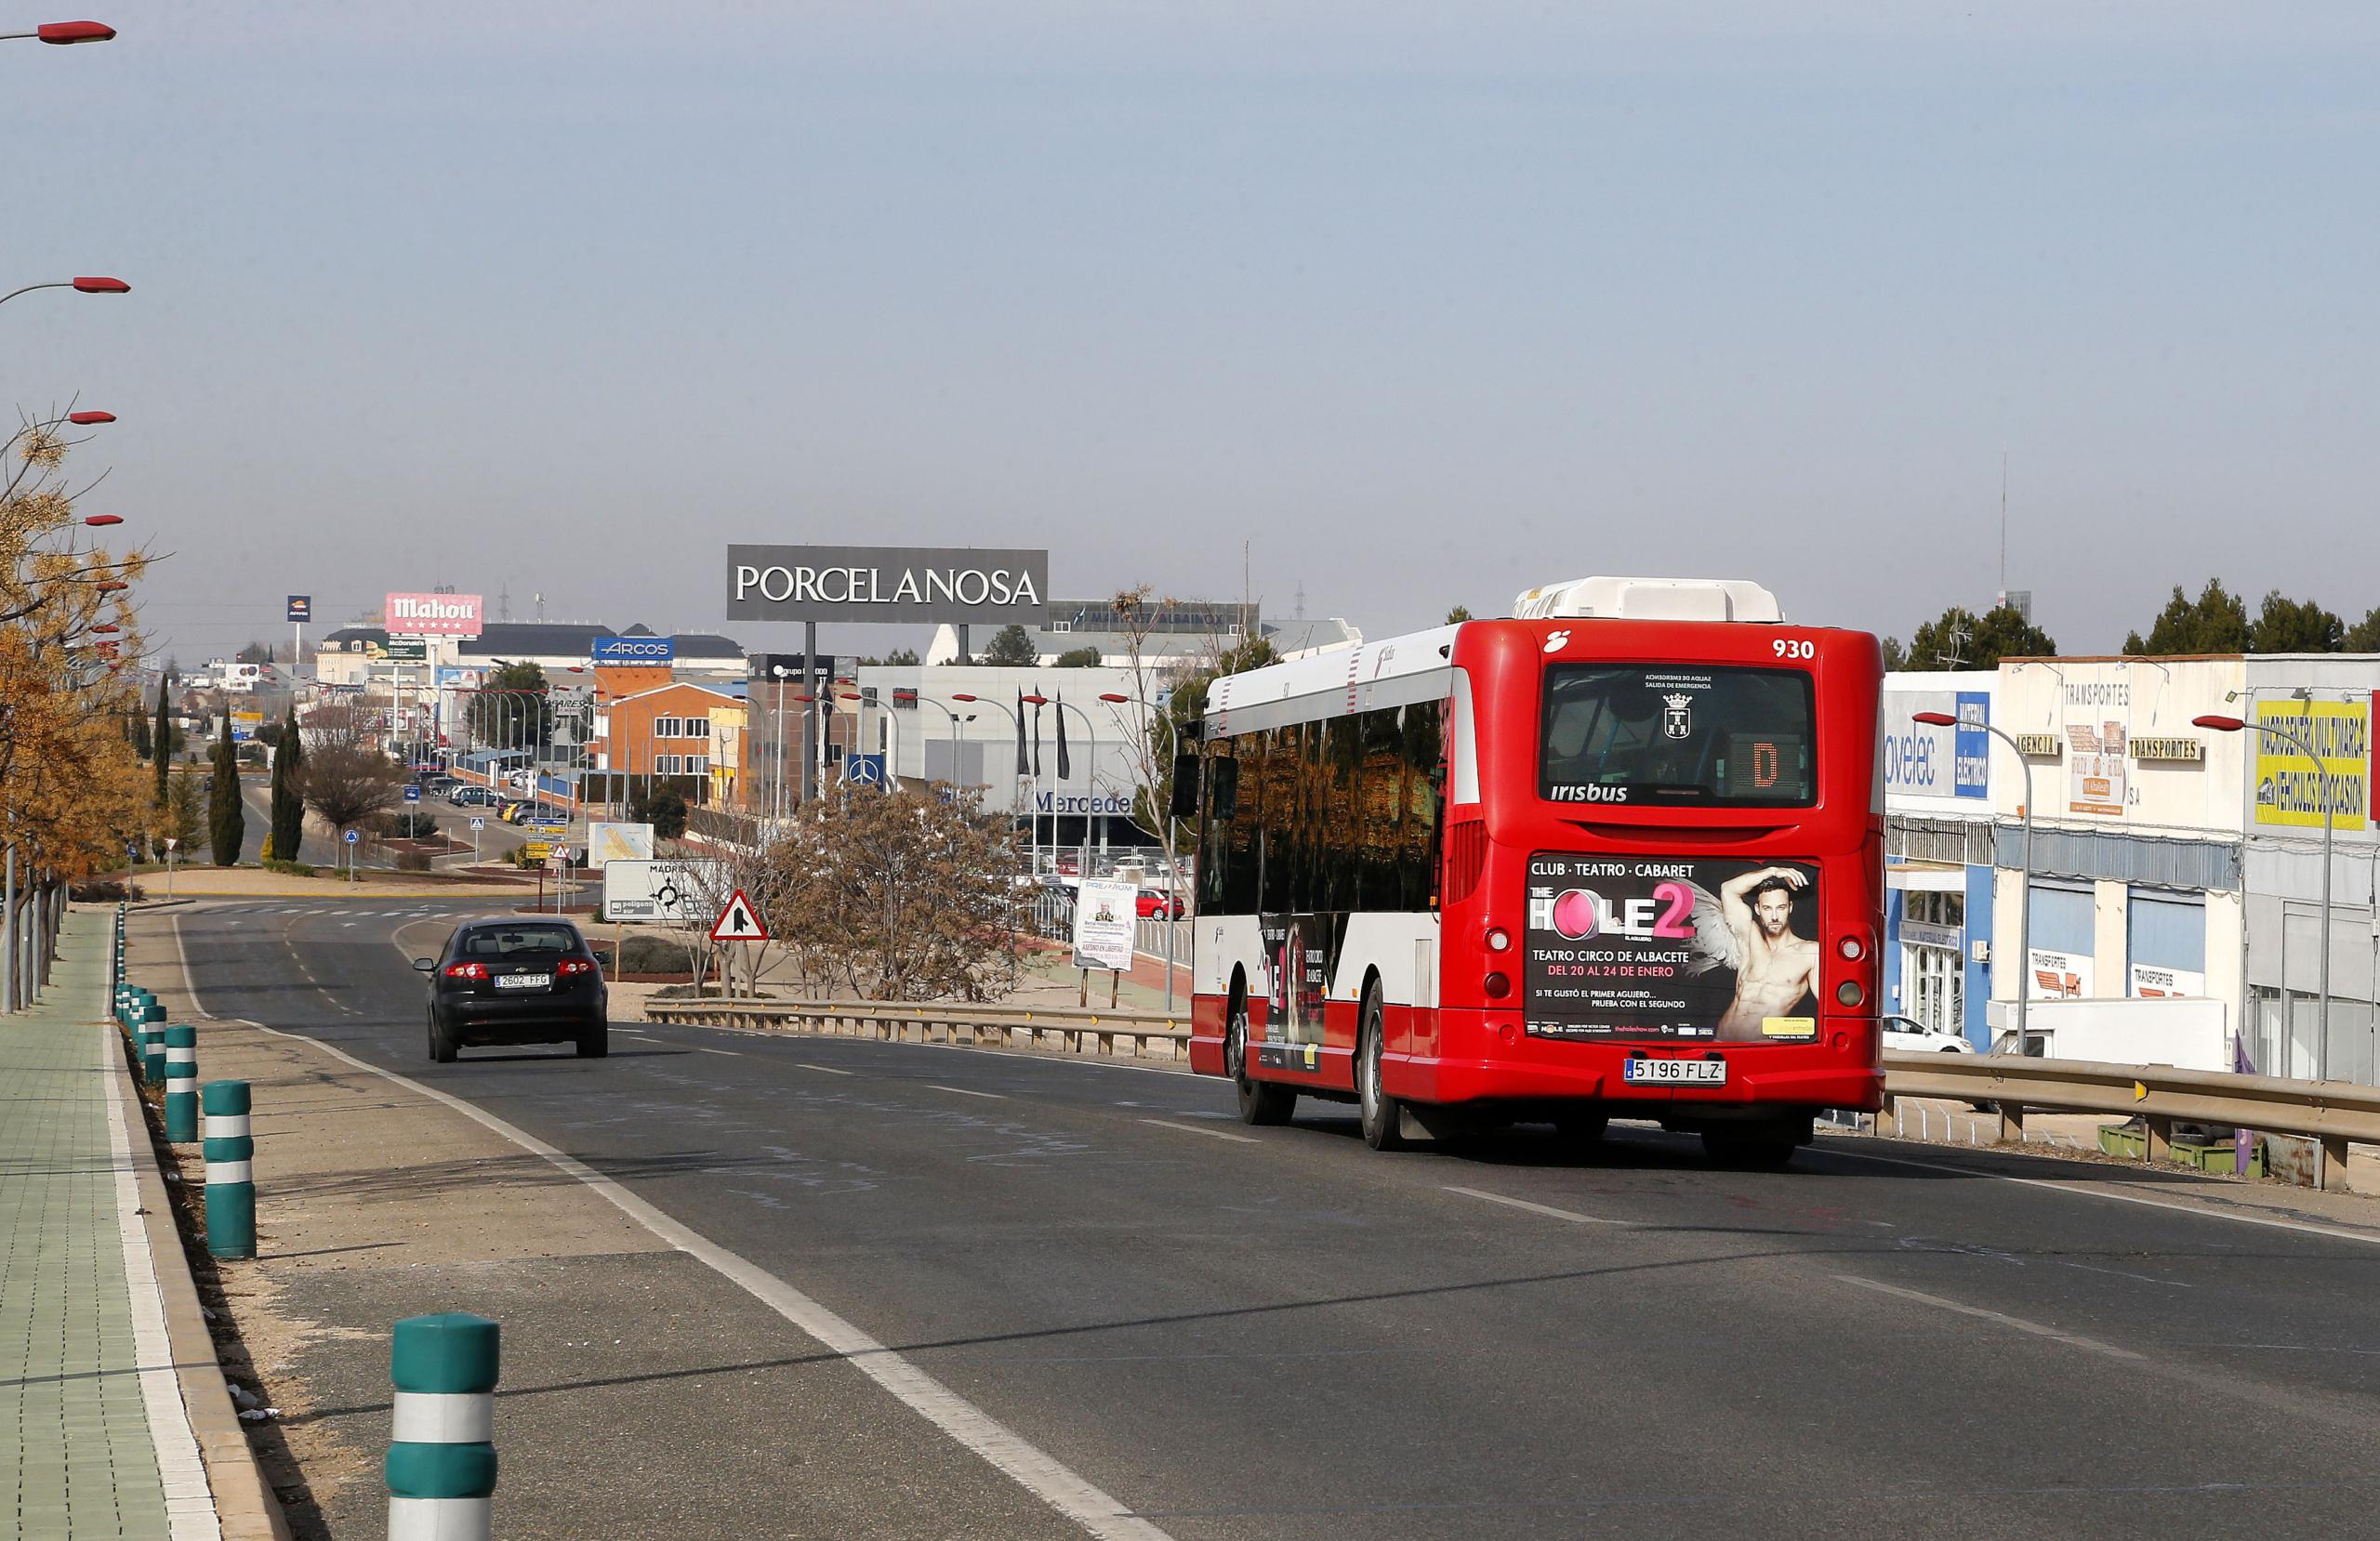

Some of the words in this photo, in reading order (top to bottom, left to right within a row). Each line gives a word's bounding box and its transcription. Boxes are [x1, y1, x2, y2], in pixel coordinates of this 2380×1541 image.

[735, 564, 1041, 606] PORCELANOSA
[393, 598, 474, 619] Mahou
[601, 641, 668, 655] ARCOS
[1772, 639, 1815, 659] 930
[2065, 684, 2129, 706] TRANSPORTES
[2315, 716, 2365, 758] MULTIMARCA
[2016, 735, 2054, 754] AGENCIA
[2129, 738, 2197, 759] TRANSPORTES
[1753, 743, 1778, 787] D
[1031, 791, 1136, 814] Mercede
[1550, 784, 1628, 803] irisbus
[650, 865, 686, 874] MADRID
[1530, 863, 1566, 876] CLUB
[1574, 863, 1625, 876] TEATRO
[1634, 864, 1695, 877] CABARET
[1529, 887, 1554, 898] THE
[1532, 950, 1575, 962] TEATRO
[1578, 951, 1614, 962] CIRCO
[1618, 951, 1633, 963] DE
[1634, 951, 1689, 963] ALBACETE
[2031, 953, 2067, 969] TRANSPORTES
[502, 975, 524, 985] 2602
[529, 974, 547, 984] FFG
[1548, 965, 1567, 976] DEL
[1570, 966, 1584, 976] 20
[1587, 966, 1600, 977] AL
[1604, 966, 1617, 977] 24
[1620, 966, 1634, 977] DE
[1637, 967, 1674, 978] ENERO
[2134, 968, 2174, 987] TRANSPORTES
[1535, 989, 1542, 997] SI
[1554, 988, 1580, 997] GUSTÓ
[1590, 990, 1616, 998] PRIMER
[1617, 991, 1657, 999] AGUJERO...
[1649, 1000, 1686, 1008] SEGUNDO
[1634, 1061, 1680, 1078] 5196
[1686, 1063, 1721, 1079] FLZ
